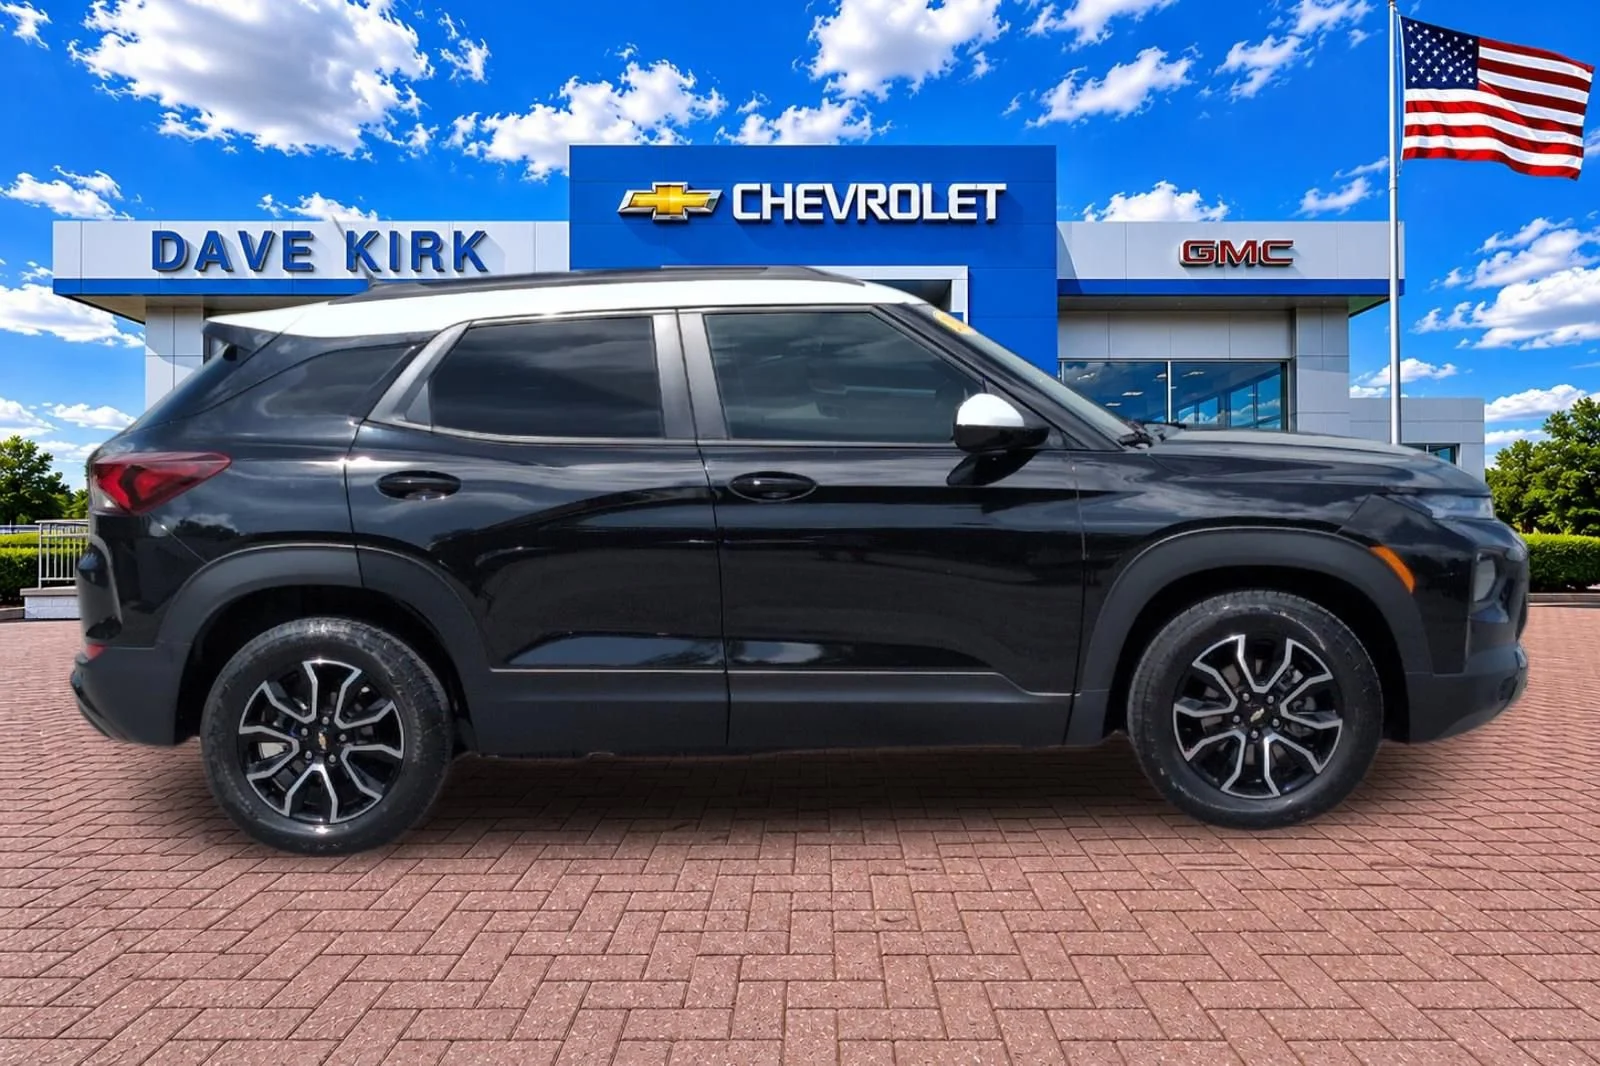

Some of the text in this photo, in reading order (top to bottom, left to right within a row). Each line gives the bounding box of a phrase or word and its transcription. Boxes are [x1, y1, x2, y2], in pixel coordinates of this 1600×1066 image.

[732, 183, 1006, 221] CHEVROLET
[151, 230, 488, 272] DAVE KIRK
[1180, 239, 1294, 267] GMC
